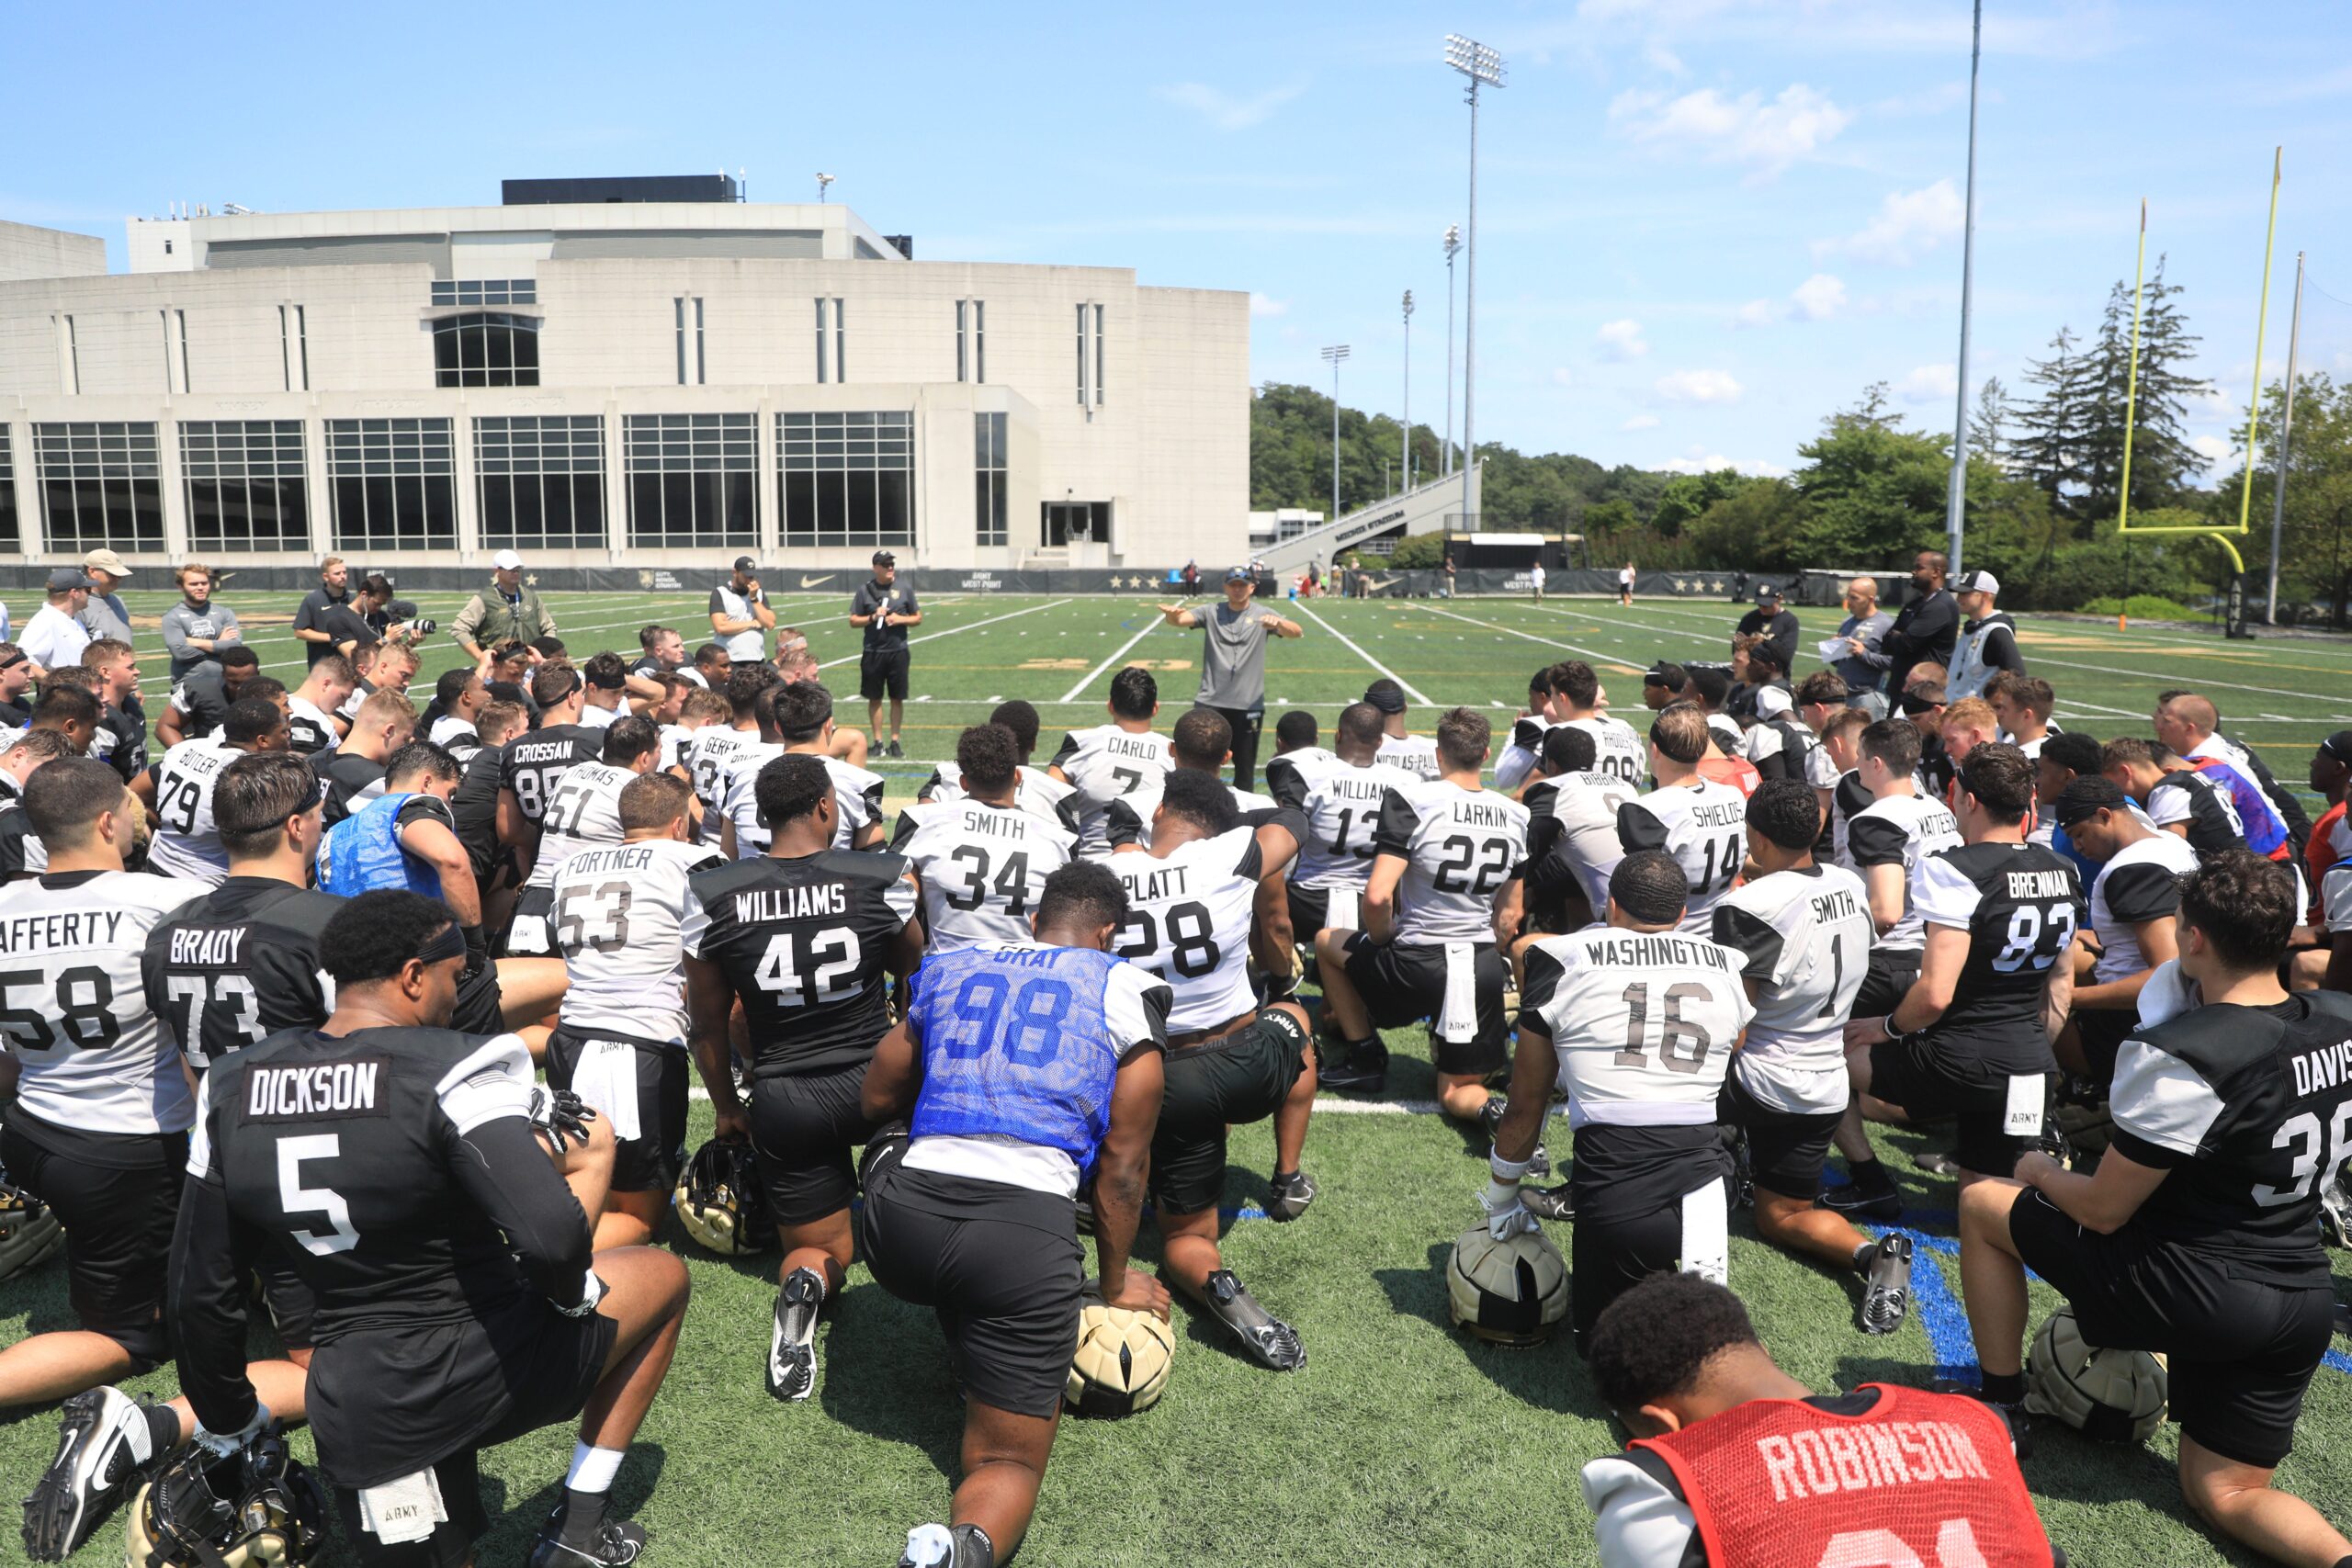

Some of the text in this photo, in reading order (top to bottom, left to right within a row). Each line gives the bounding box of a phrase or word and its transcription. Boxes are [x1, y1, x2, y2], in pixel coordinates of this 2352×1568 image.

[179, 749, 219, 776] BUTLER
[514, 740, 573, 764] CROSSAN
[1107, 737, 1157, 761] CIARLO
[569, 763, 618, 786] THOMAS
[1112, 766, 1143, 795] 7
[1332, 779, 1388, 801] WILLIAM
[157, 770, 201, 835] 79
[543, 785, 594, 839] 51
[1453, 801, 1507, 828] LARKIN
[1691, 801, 1745, 827] SHIELDS
[964, 811, 1025, 840] SMITH
[566, 848, 653, 877] FORTNER
[945, 844, 1030, 917] 34
[1433, 834, 1510, 895] 22
[1690, 833, 1739, 895] 14
[1122, 865, 1188, 902] PLATT
[2007, 870, 2071, 899] BRENNAN
[558, 880, 632, 958] 53
[735, 883, 846, 923] WILLIAMS
[1811, 889, 1856, 924] SMITH
[170, 927, 246, 964] BRADY
[1114, 900, 1221, 980] 28
[1586, 937, 1729, 974] WASHINGTON
[1992, 902, 2075, 972] 83
[753, 926, 865, 1007] 42
[993, 945, 1065, 969] GRAY
[1817, 933, 1843, 1020] 1
[0, 965, 121, 1051] 58
[166, 975, 268, 1067] 73
[944, 972, 1074, 1069] 98
[1264, 1012, 1299, 1039] ARMY
[1448, 1021, 1471, 1031] ARMY
[1614, 982, 1713, 1074] 16
[2291, 1039, 2352, 1097] DAVIS
[249, 1063, 379, 1116] DICKSON
[2011, 1112, 2038, 1124] ARMY
[277, 1134, 361, 1257] 5
[1757, 1421, 1992, 1503] ROBINSON
[386, 1505, 418, 1522] ARMY
